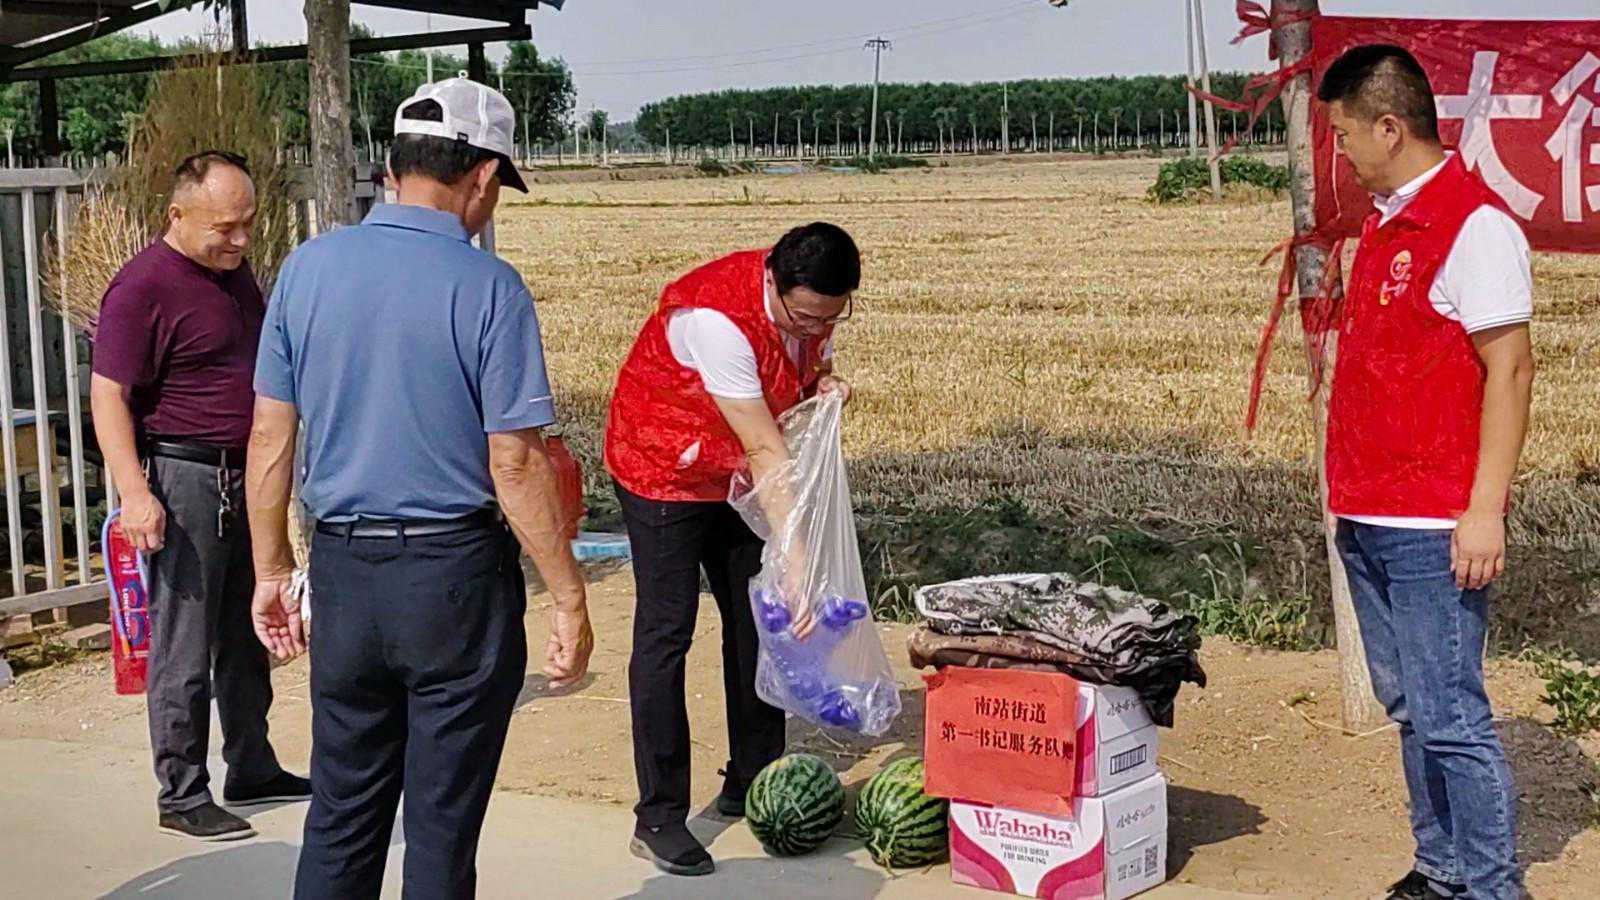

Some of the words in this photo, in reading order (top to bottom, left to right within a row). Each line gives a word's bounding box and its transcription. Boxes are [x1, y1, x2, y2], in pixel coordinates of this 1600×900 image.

[974, 696, 1047, 724] 南站街道
[974, 809, 1072, 843] Wahaha
